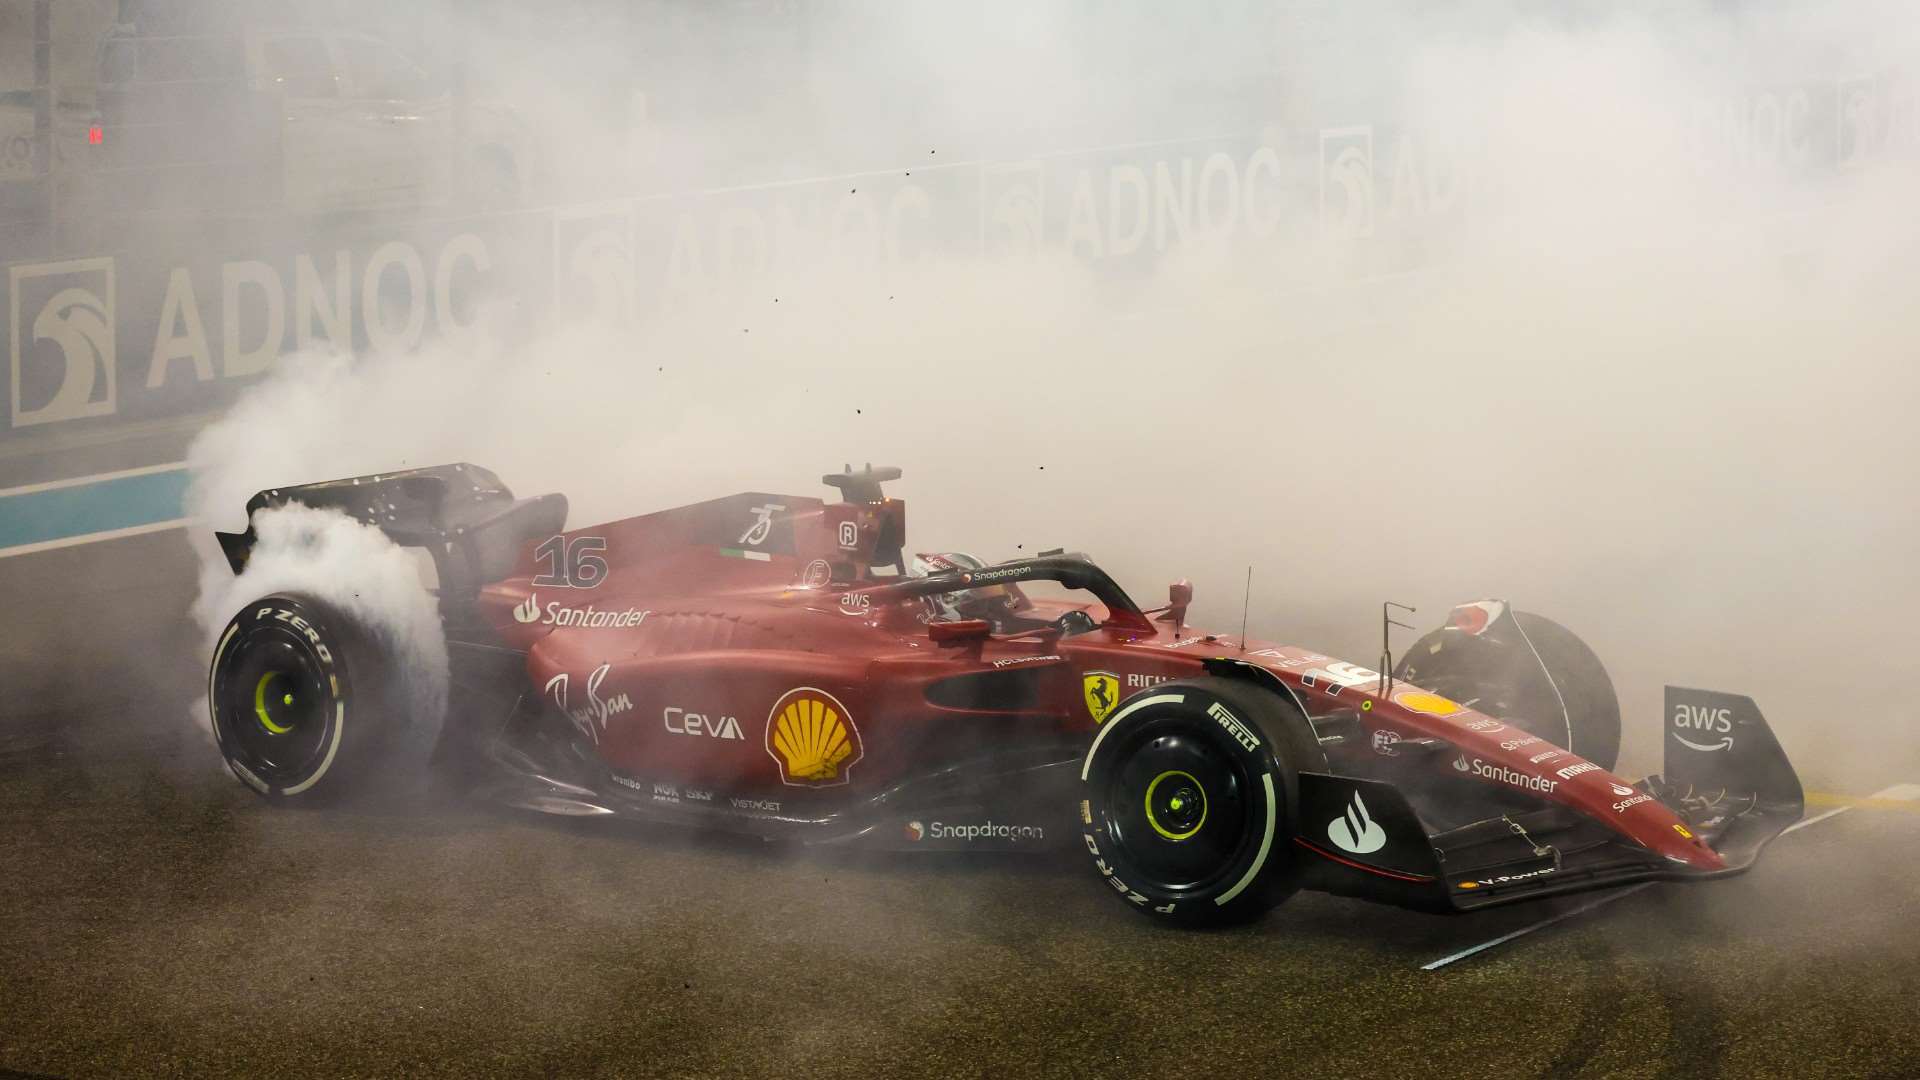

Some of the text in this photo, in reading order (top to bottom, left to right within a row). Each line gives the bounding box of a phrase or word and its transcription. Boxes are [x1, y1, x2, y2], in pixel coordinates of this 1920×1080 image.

[1067, 147, 1279, 256] ADNOC
[147, 233, 490, 388] ADNOC
[531, 535, 608, 589] 16
[973, 566, 1031, 582] Snapdragon
[542, 601, 652, 628] Santander
[841, 592, 869, 608] aws
[256, 608, 333, 664] P ZERO
[1206, 702, 1261, 752] PIRELLI
[1673, 704, 1731, 732] aws
[1472, 759, 1558, 793] Santander
[930, 820, 1044, 841] Snapdragon
[1477, 867, 1556, 885] V-Power
